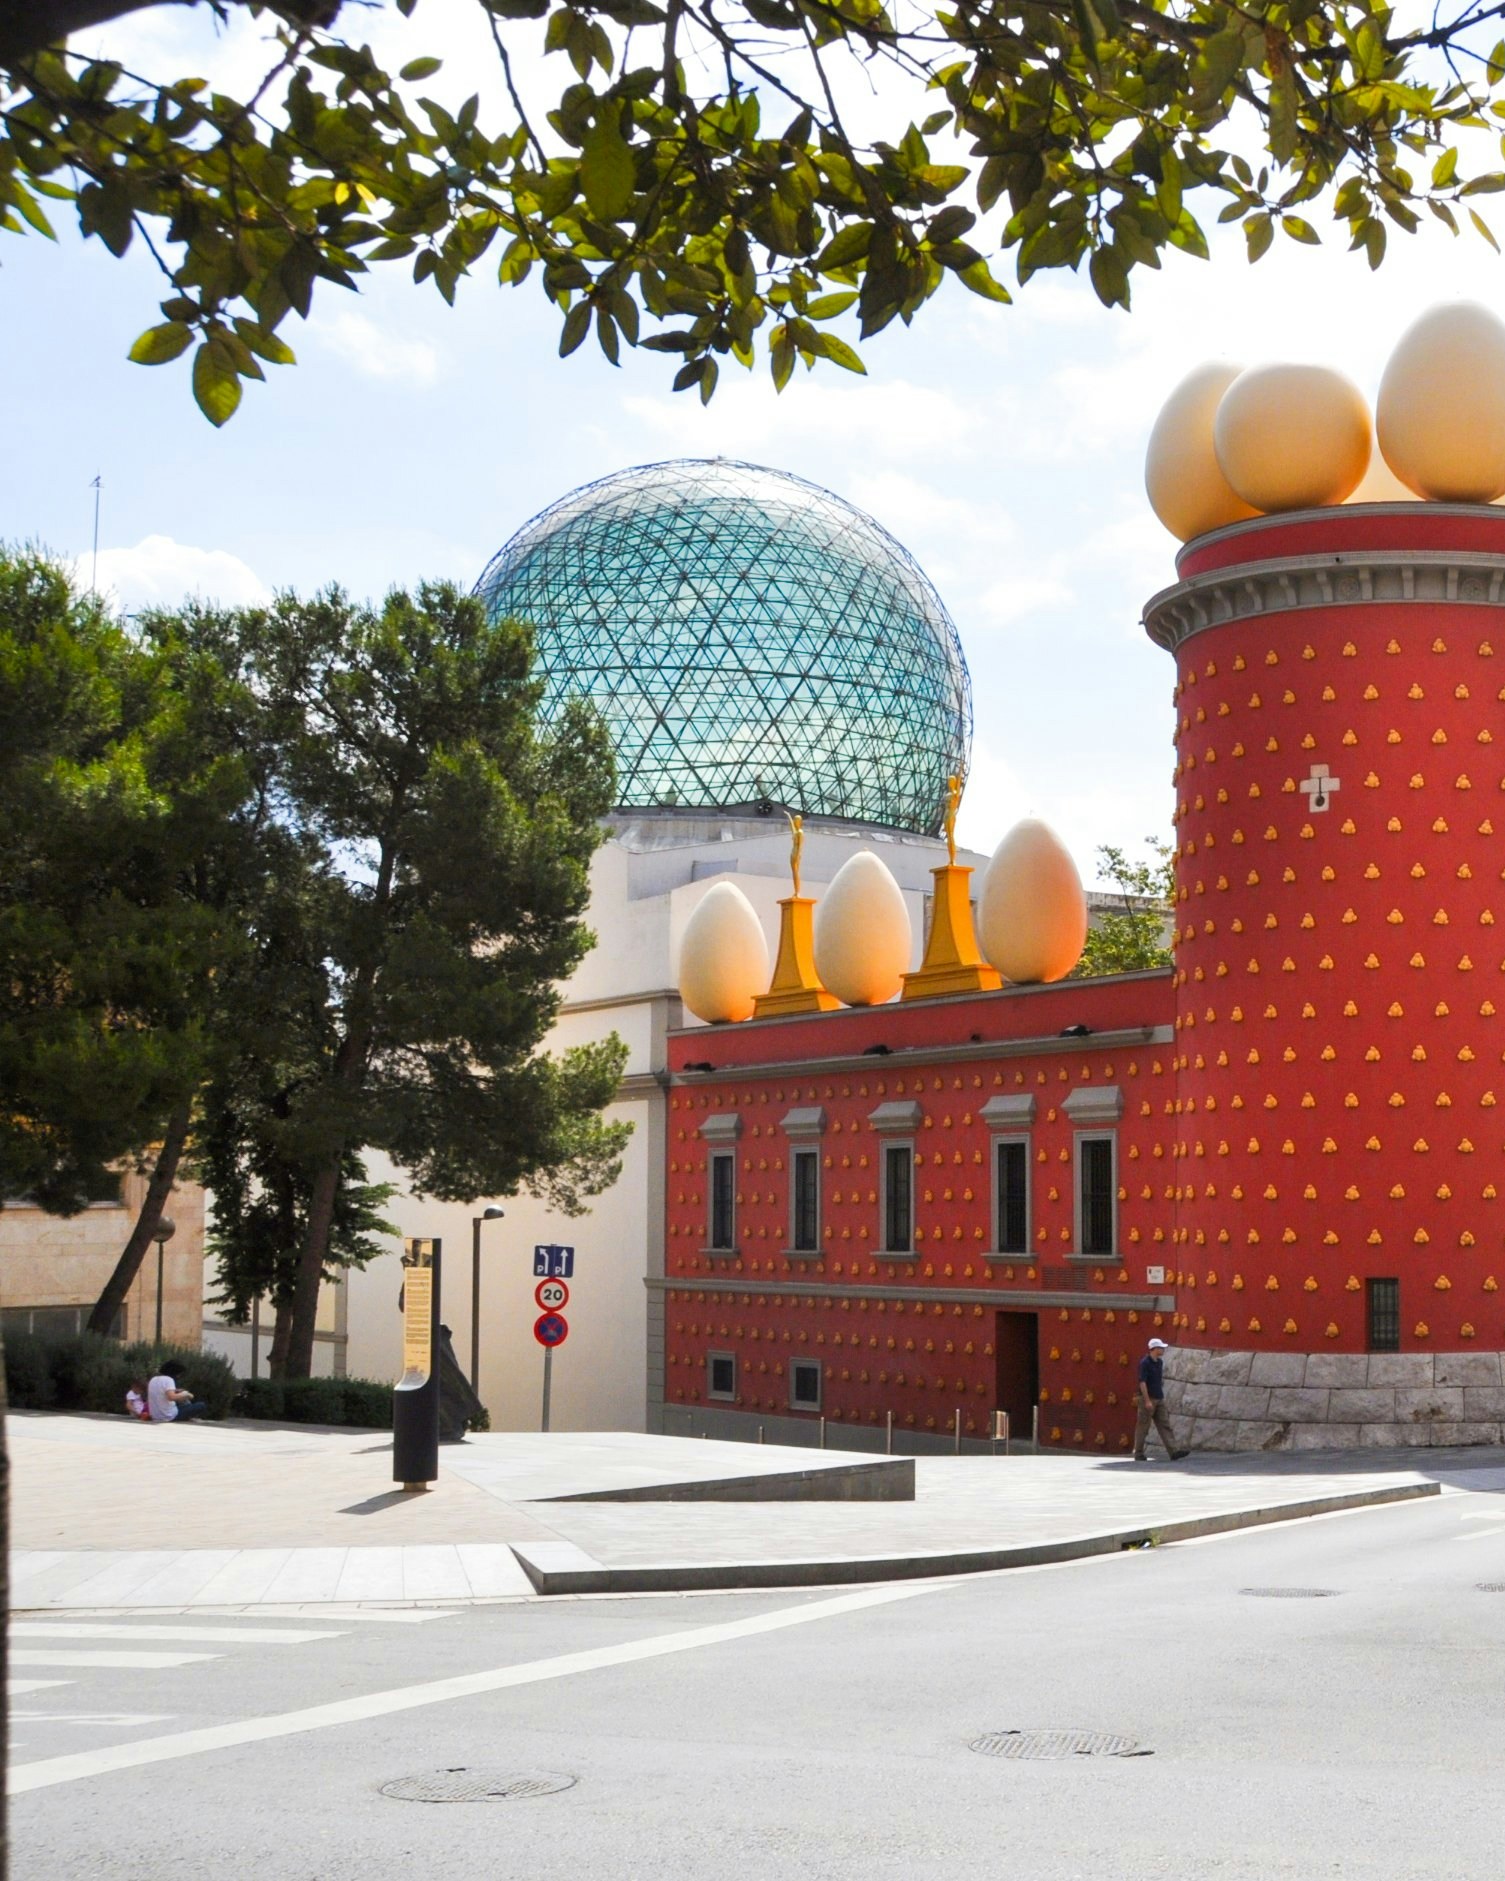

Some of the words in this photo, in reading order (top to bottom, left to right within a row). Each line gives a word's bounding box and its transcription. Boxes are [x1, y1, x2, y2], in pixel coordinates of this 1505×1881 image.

[537, 1265, 544, 1274] P
[555, 1266, 562, 1275] P
[543, 1288, 563, 1301] 20
